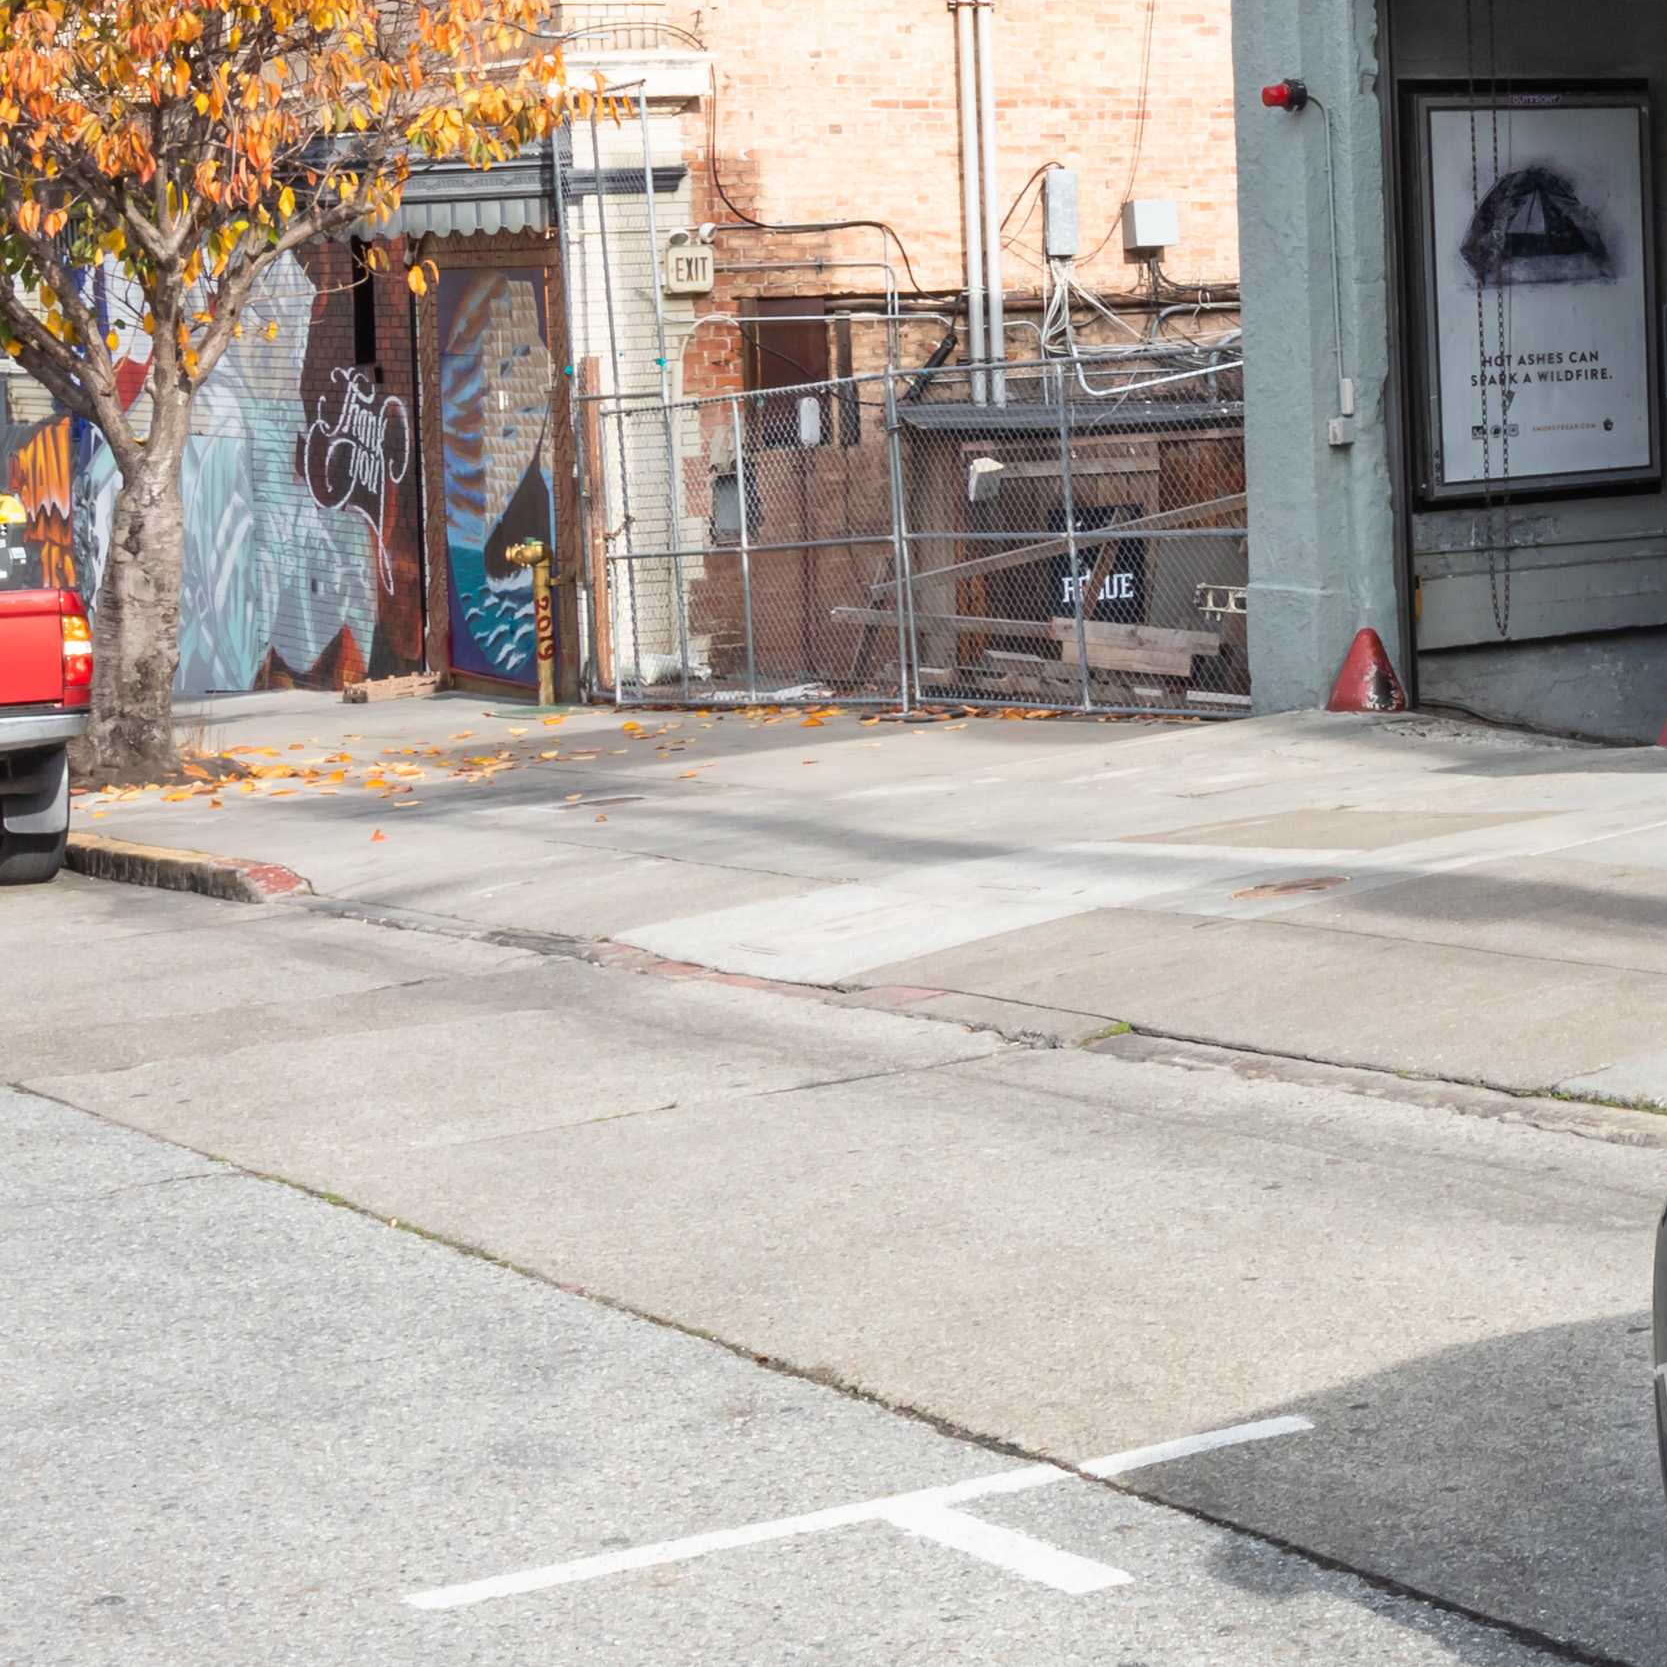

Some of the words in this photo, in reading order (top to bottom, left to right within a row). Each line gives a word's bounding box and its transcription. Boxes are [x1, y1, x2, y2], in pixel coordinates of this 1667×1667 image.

[676, 257, 708, 282] EXIT
[1483, 355, 1512, 368] HOT
[1518, 353, 1563, 365] ASHES
[1569, 351, 1599, 363] CAN
[1471, 374, 1518, 387] SPARK
[1523, 372, 1532, 383] A
[1537, 368, 1613, 382] WILDFIRE.
